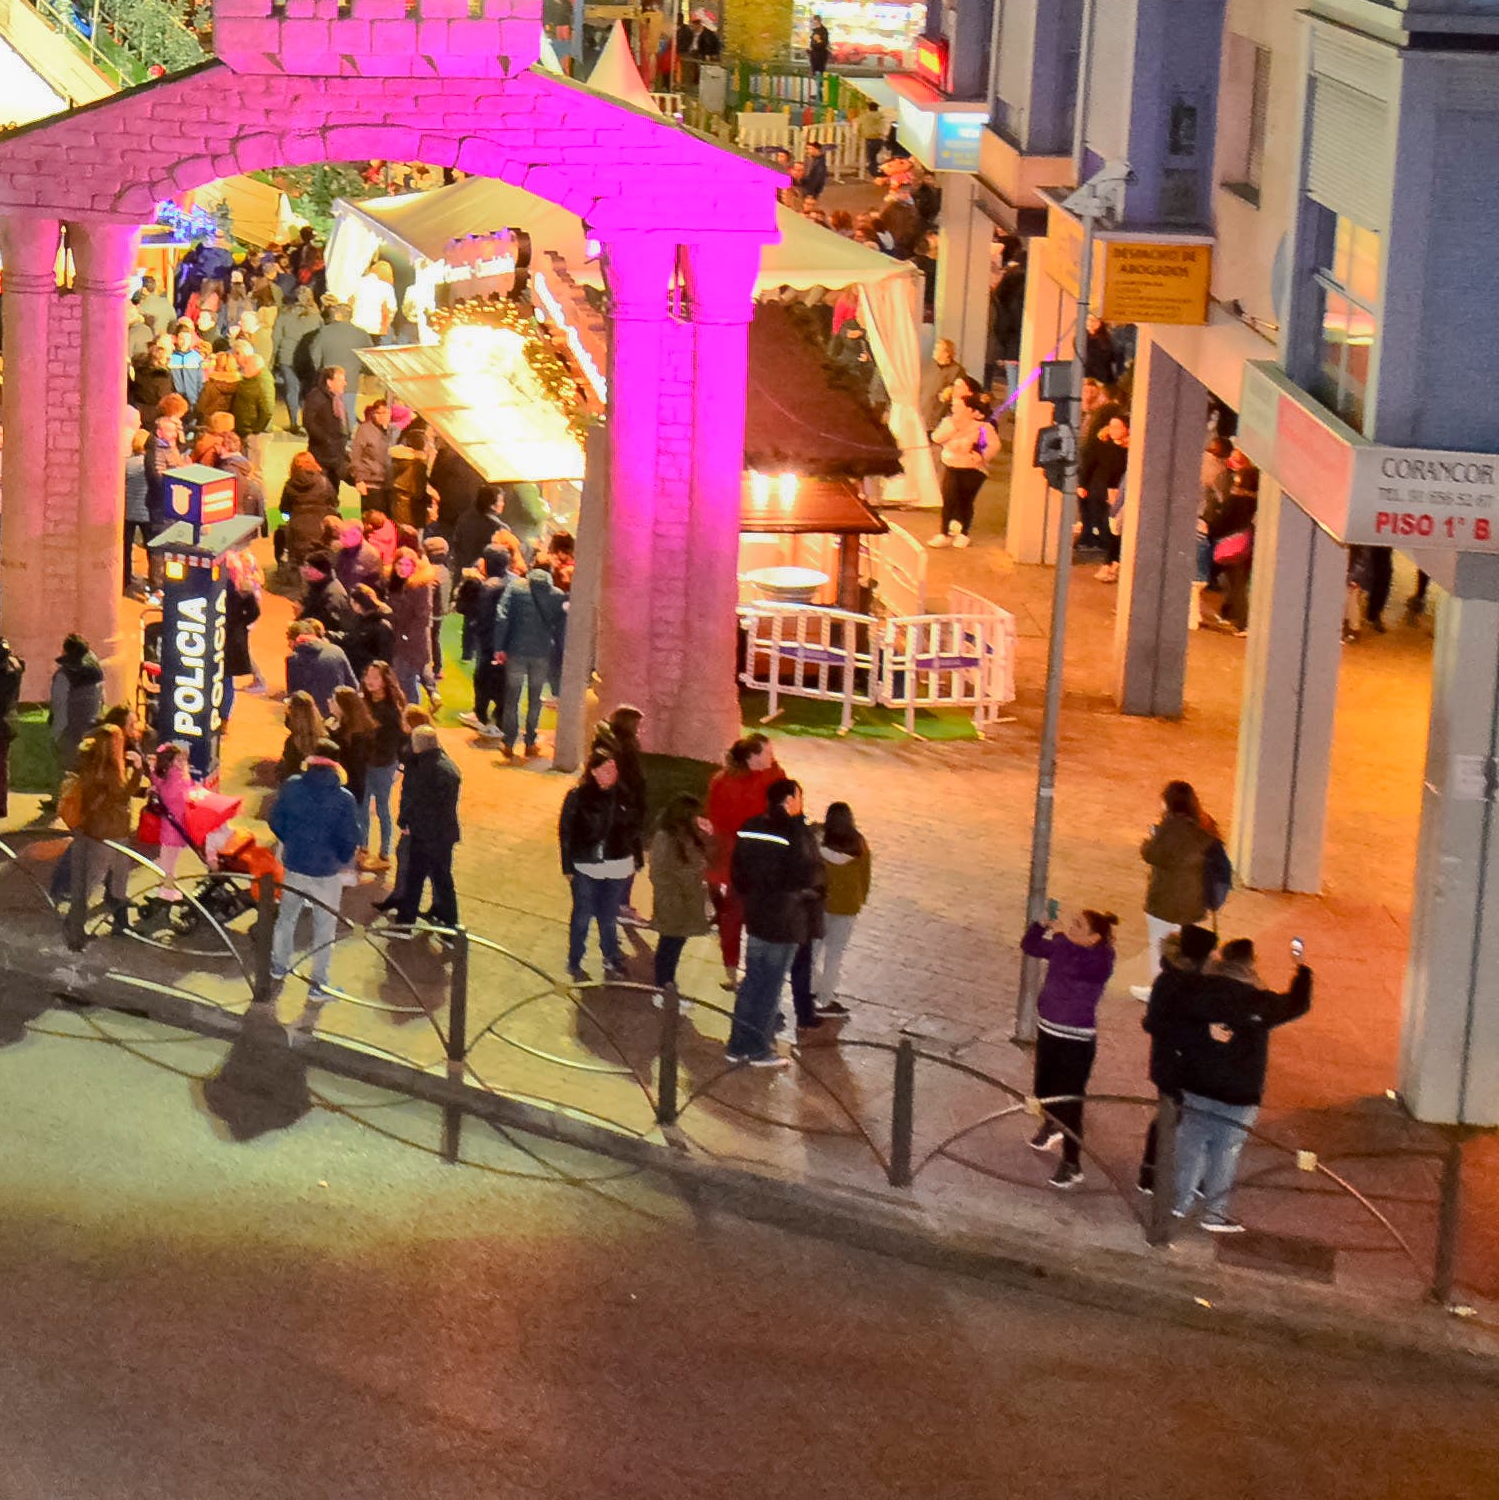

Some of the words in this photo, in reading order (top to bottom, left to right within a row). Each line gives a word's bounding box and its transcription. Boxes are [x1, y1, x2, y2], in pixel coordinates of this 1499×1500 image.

[1120, 264, 1189, 277] ABOGADOS
[1375, 511, 1435, 537] PISO
[1473, 517, 1491, 541] B
[173, 597, 207, 735] POLICIA
[210, 588, 226, 731] POLICIA
